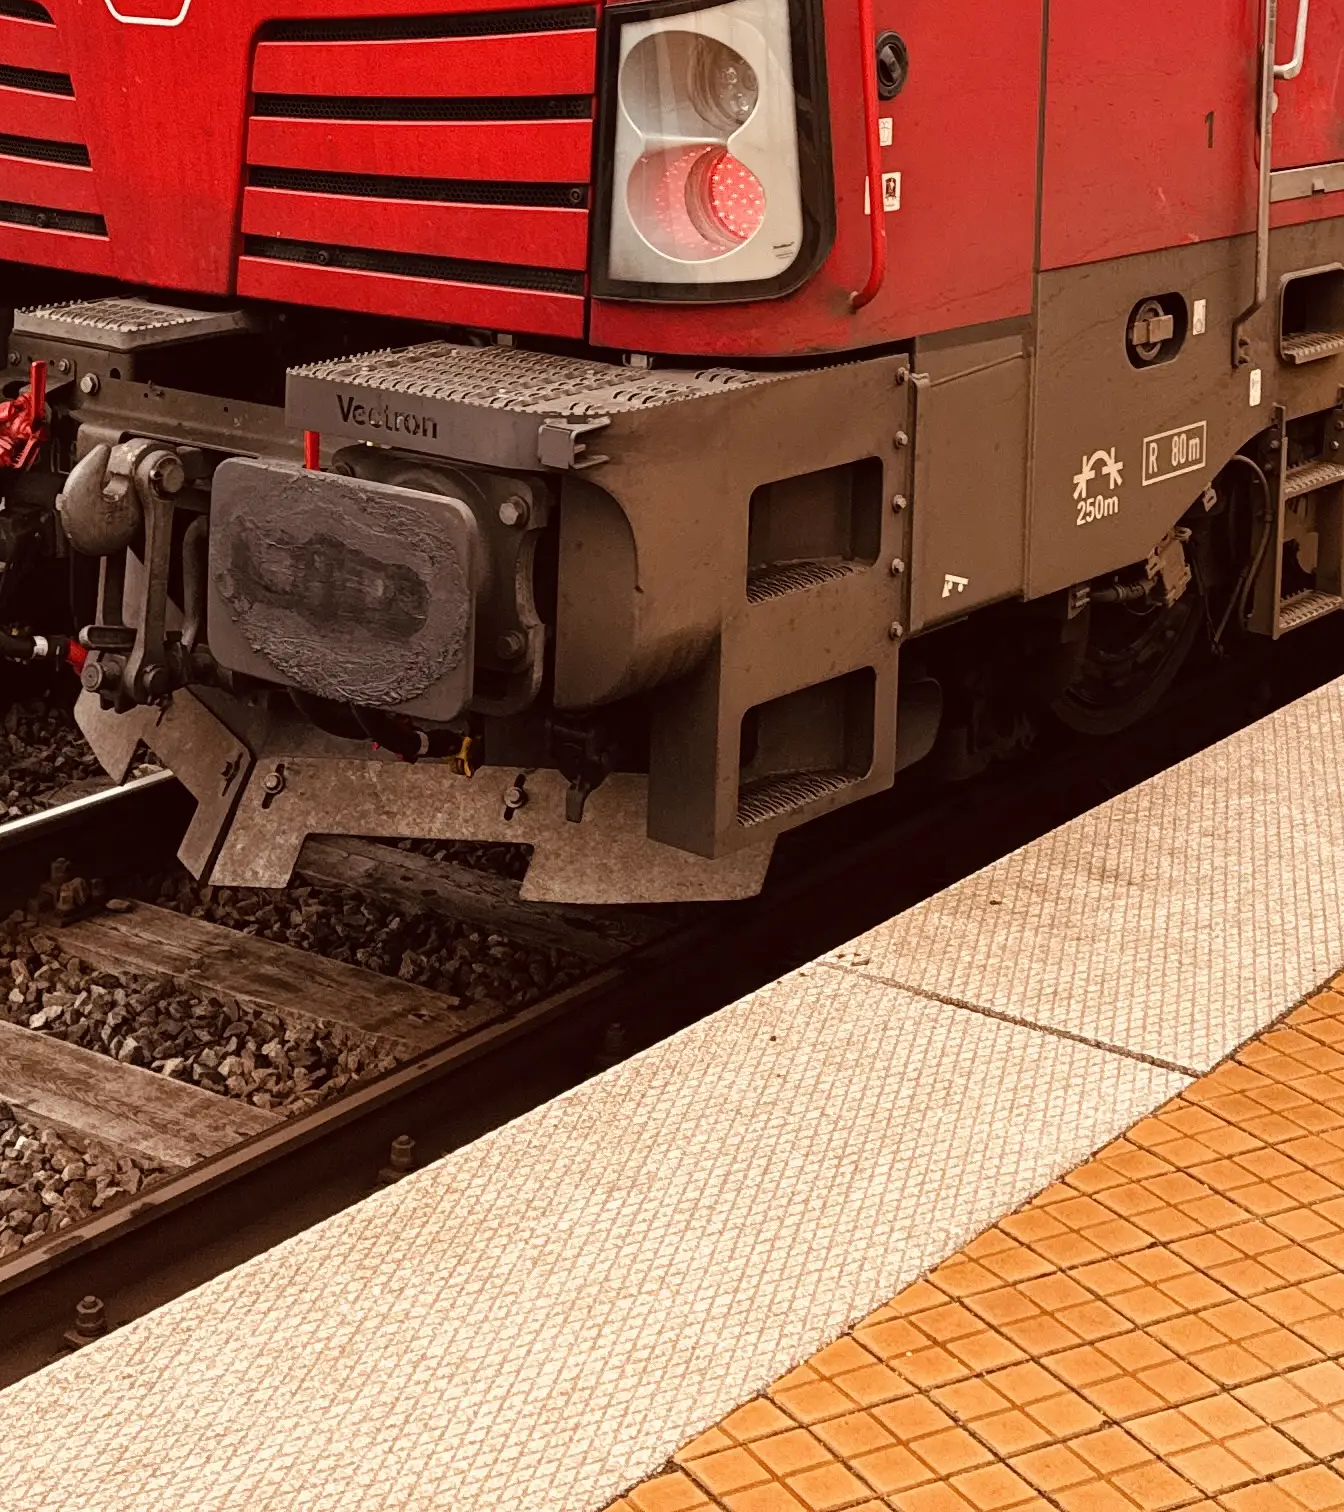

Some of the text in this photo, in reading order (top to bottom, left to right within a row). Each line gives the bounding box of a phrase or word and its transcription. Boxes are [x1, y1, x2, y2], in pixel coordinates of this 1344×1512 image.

[1205, 111, 1215, 149] 1
[336, 394, 438, 439] Vectron
[1148, 442, 1158, 474] R
[1076, 494, 1119, 526] 250m
